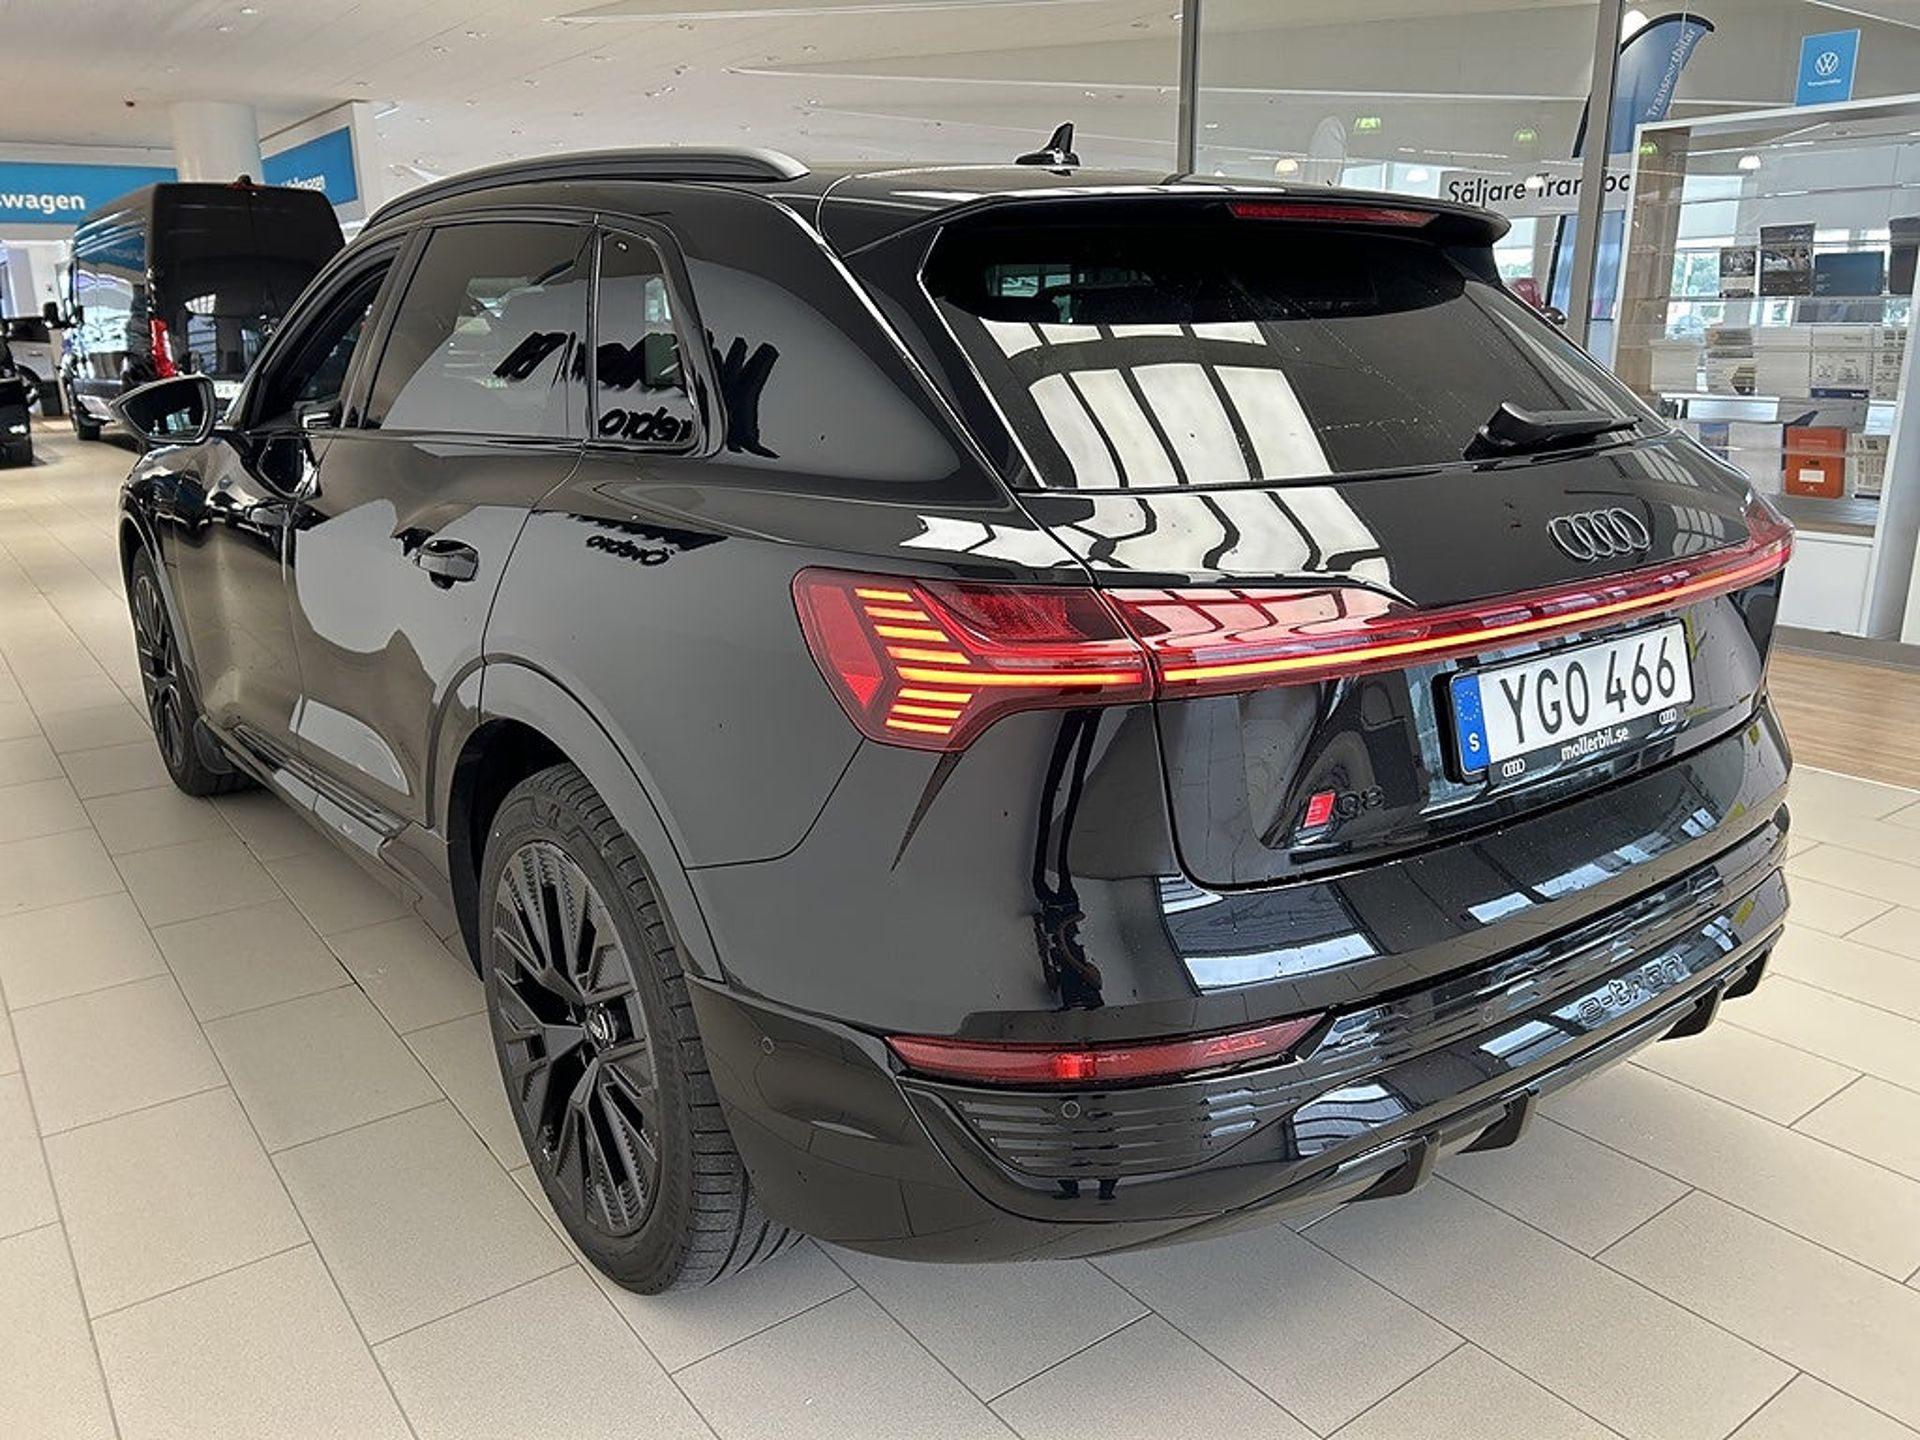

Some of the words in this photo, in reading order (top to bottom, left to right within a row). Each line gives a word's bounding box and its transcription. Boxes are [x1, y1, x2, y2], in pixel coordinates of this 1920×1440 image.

[1646, 28, 1696, 117] Transportbilar
[0, 193, 86, 215] wagen
[1448, 177, 1526, 208] Säljare
[1499, 660, 1590, 745] YGO
[1605, 636, 1676, 714] 466
[1468, 732, 1480, 752] S
